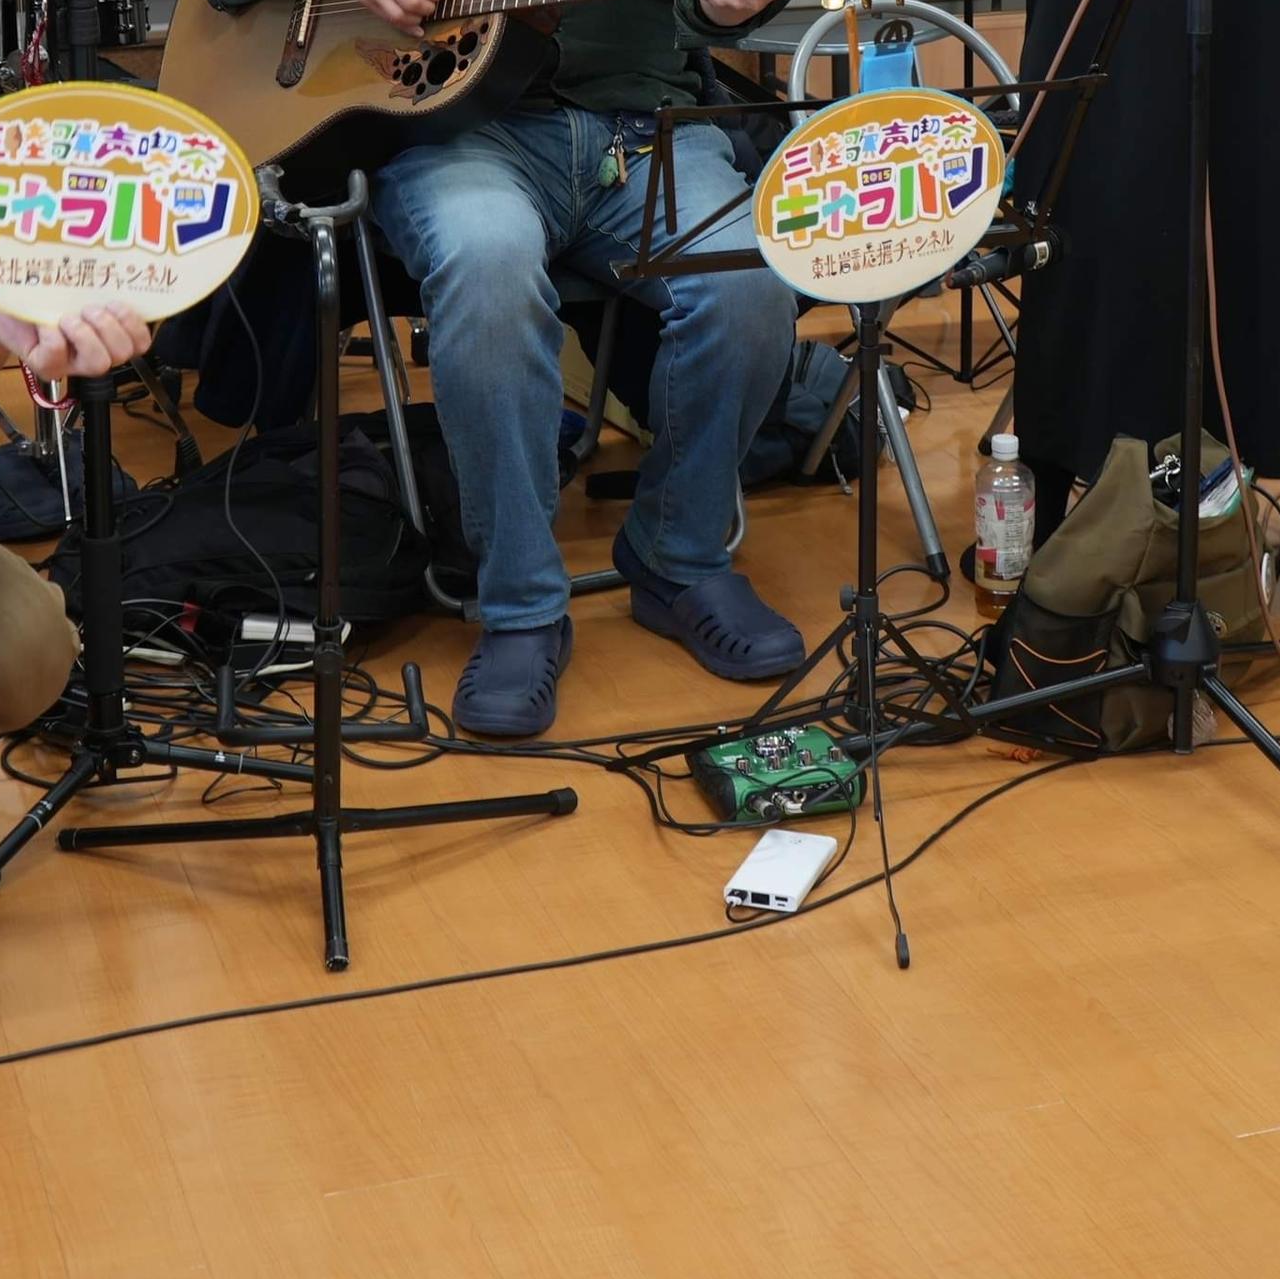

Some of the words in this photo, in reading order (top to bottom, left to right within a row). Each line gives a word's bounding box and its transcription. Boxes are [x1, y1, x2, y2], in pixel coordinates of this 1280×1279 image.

[784, 113, 972, 181] 三陸歌声喫茶
[776, 146, 984, 241] キャラバン
